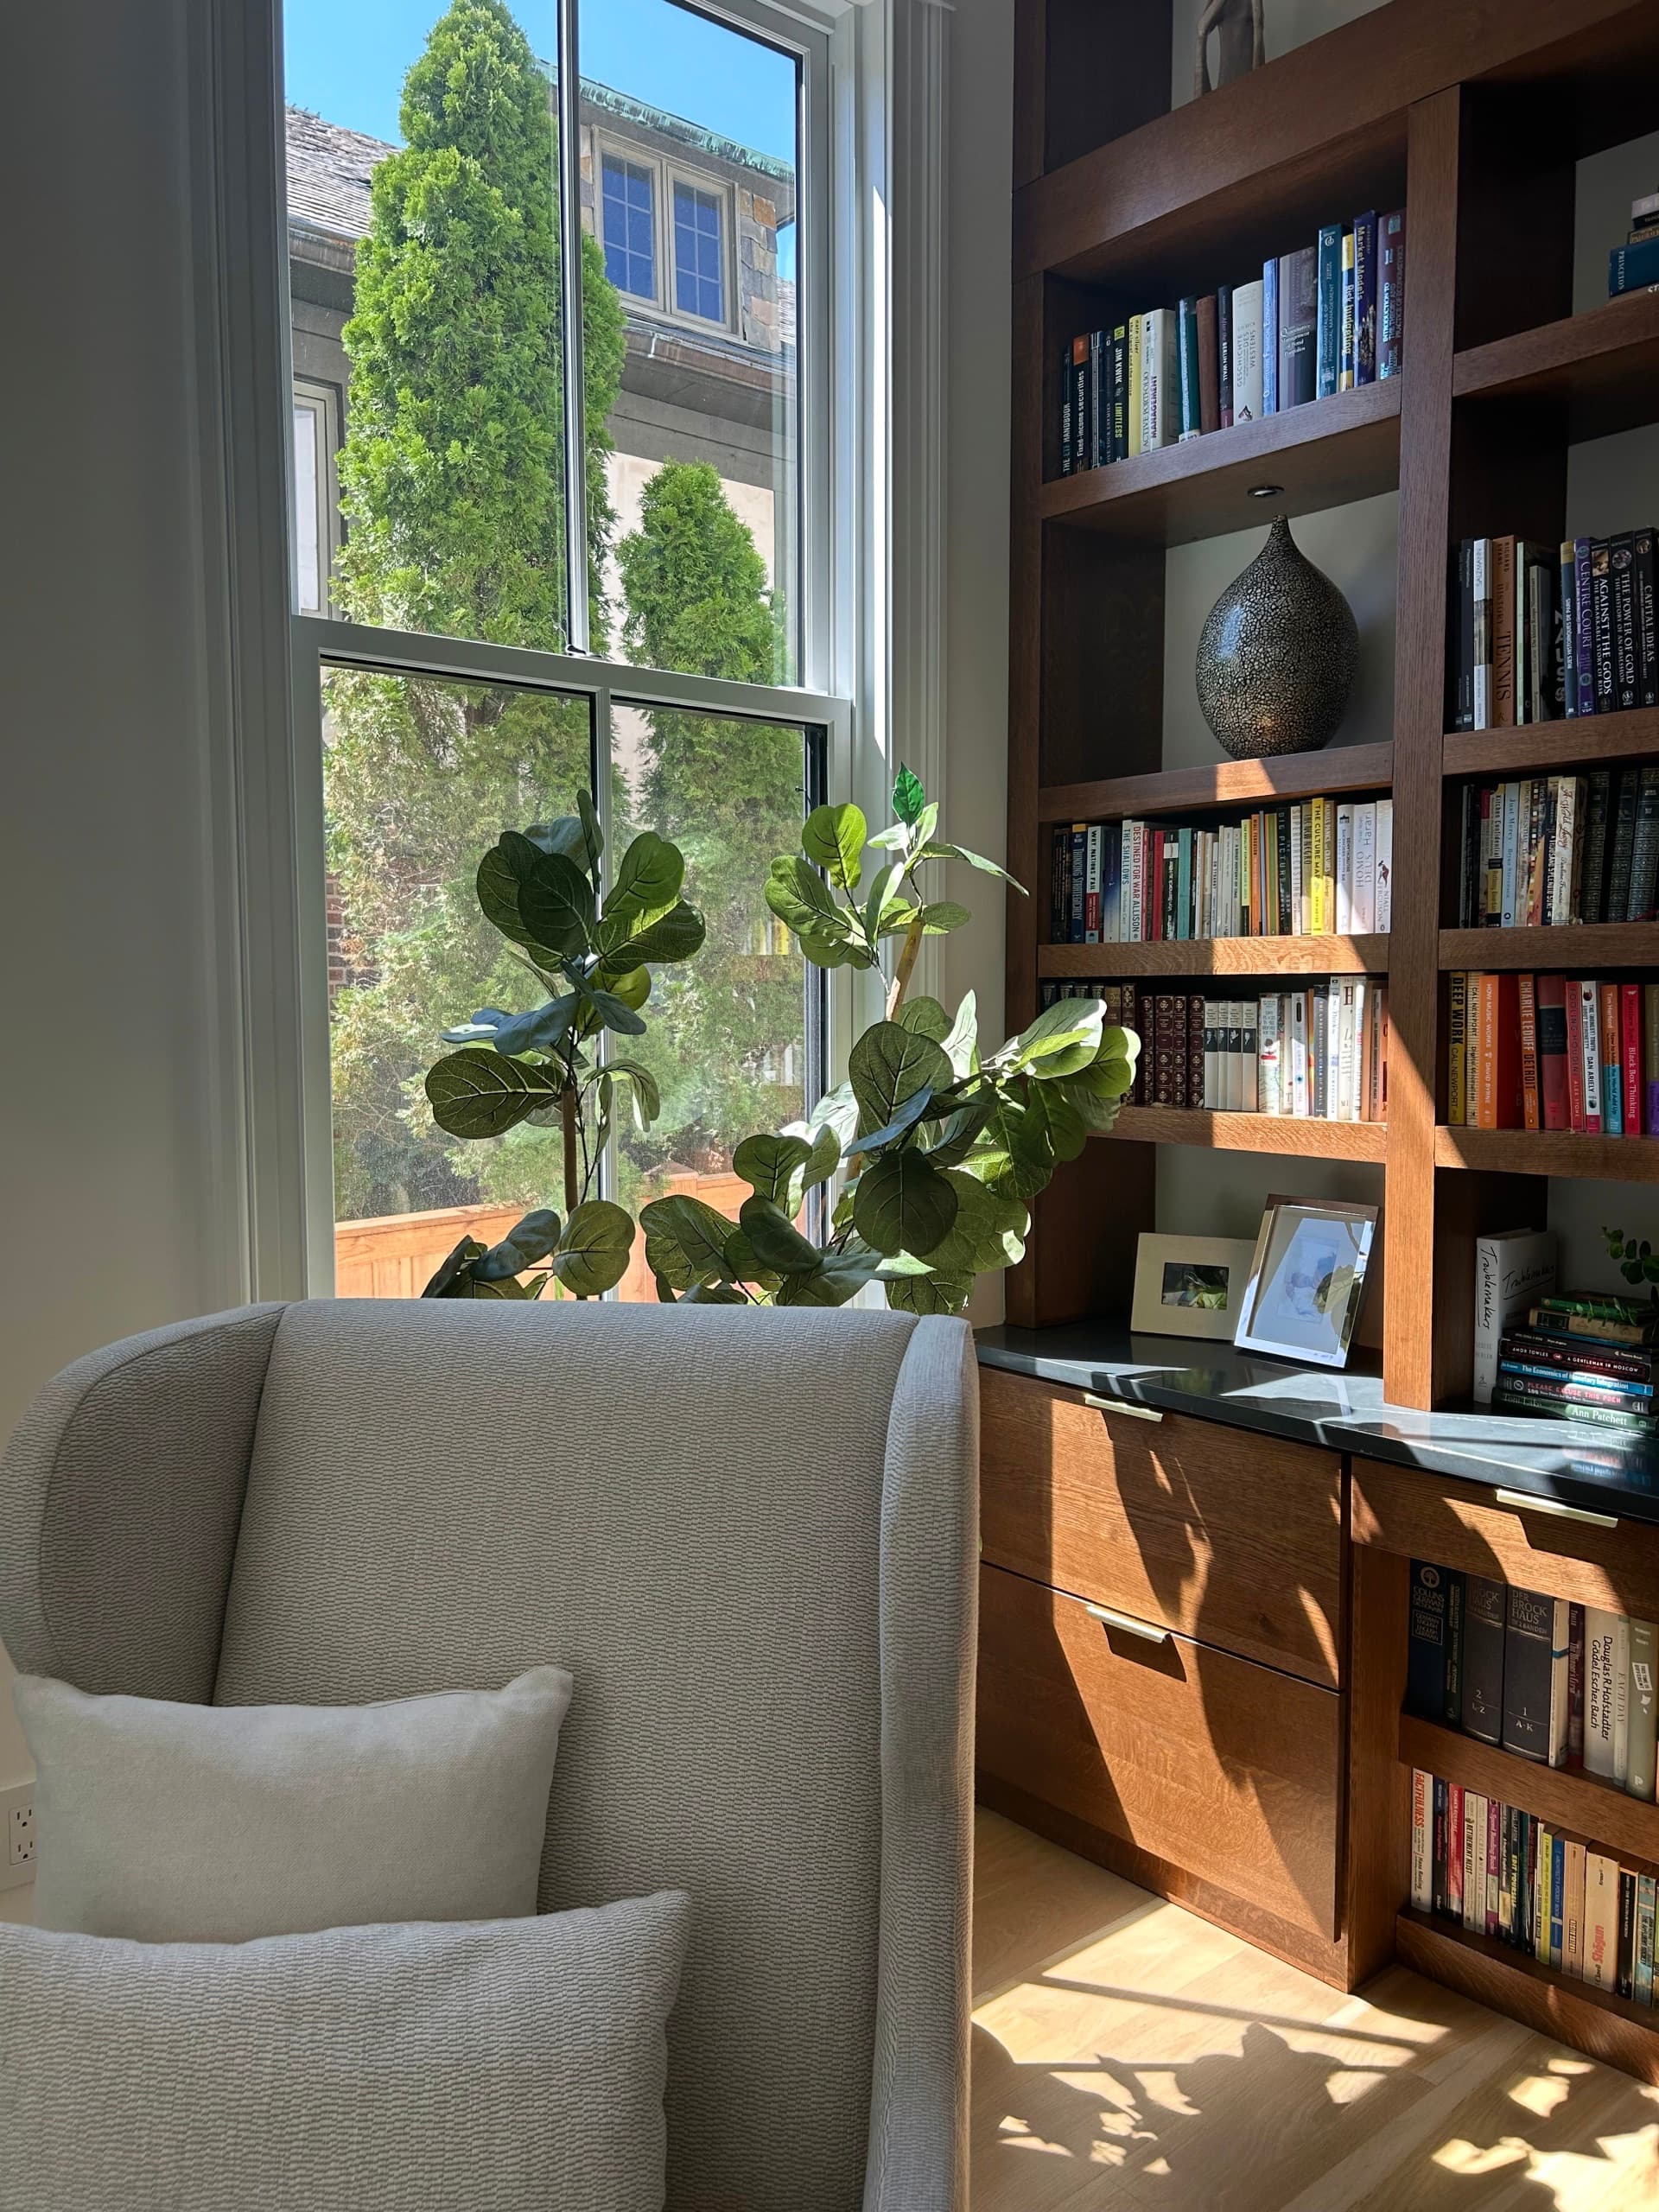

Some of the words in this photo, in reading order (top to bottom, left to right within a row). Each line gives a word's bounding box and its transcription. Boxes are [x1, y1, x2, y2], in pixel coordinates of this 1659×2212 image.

[1342, 304, 1354, 355] budgeting
[1077, 370, 1085, 411] securities
[1115, 402, 1123, 439] LIMITLESS
[1580, 561, 1592, 607] CENTRE
[1620, 572, 1631, 595] THE
[1599, 578, 1610, 628] AGAINST
[1621, 596, 1632, 638] POWER
[1643, 584, 1654, 631] CAPITAL
[1581, 608, 1593, 650] COURT
[1617, 624, 1624, 633] OF
[1600, 629, 1611, 658] THE
[1623, 638, 1633, 652] OF
[1645, 631, 1656, 663] IDEAS
[1496, 631, 1512, 702] TENNIS
[1597, 666, 1604, 677] OF
[1602, 661, 1612, 696] GODS
[1624, 653, 1635, 684] GOLD
[1122, 829, 1131, 842] THE
[1363, 811, 1373, 847] Harari
[1507, 817, 1516, 841] Mercy
[1133, 826, 1141, 863] DESTINED
[1548, 840, 1556, 868] THOUSAND
[1122, 844, 1130, 886] SHALLOWS
[1355, 851, 1364, 888] HOMO
[1363, 855, 1373, 883] DEUS
[1132, 900, 1141, 932] ALLISON
[1546, 895, 1554, 910] SUNS
[1451, 976, 1465, 1006] DEEP
[1520, 982, 1534, 1018] CHARLIE
[1451, 1007, 1465, 1045] WORK
[1522, 1020, 1535, 1052] LEDUFF
[1450, 1047, 1459, 1065] CAL
[1628, 1046, 1637, 1067] Black
[1523, 1053, 1536, 1090] DETROIT
[1587, 1071, 1596, 1093] ARIELY
[1628, 1069, 1637, 1084] Box
[1628, 1084, 1637, 1119] Thinking
[1480, 1246, 1498, 1331] Troublemakers
[1529, 1349, 1549, 1357] TOWLES
[1572, 1357, 1604, 1367] GENTLEMAN
[1612, 1363, 1640, 1373] MOSCOW
[1522, 1364, 1533, 1374] The
[1532, 1366, 1562, 1378] Economics
[1562, 1370, 1568, 1379] of
[1595, 1376, 1630, 1390] Integration
[1585, 1390, 1599, 1400] THIS
[1572, 1406, 1591, 1419] Ann
[1591, 1409, 1629, 1427] Patchett
[1413, 1585, 1445, 1601] COLLINS
[1511, 1597, 1548, 1618] BROCK
[1512, 1589, 1529, 1603] DER
[1511, 1607, 1540, 1625] HAUS
[1600, 1635, 1613, 1678] Douglas
[1617, 1672, 1625, 1702] EACH
[1635, 1664, 1645, 1690] DIFFERENT
[1471, 1701, 1485, 1714] L-Z
[1475, 1688, 1483, 1700] 2
[1522, 1707, 1527, 1716] 1
[1590, 1704, 1600, 1729] Bach
[1601, 1686, 1612, 1741] Hofstadter
[1617, 1703, 1625, 1725] DAY
[1414, 1771, 1425, 1828] FACTFULNESS
[1465, 1823, 1474, 1859] RETIREMENT
[1465, 1858, 1474, 1875] HEIST
